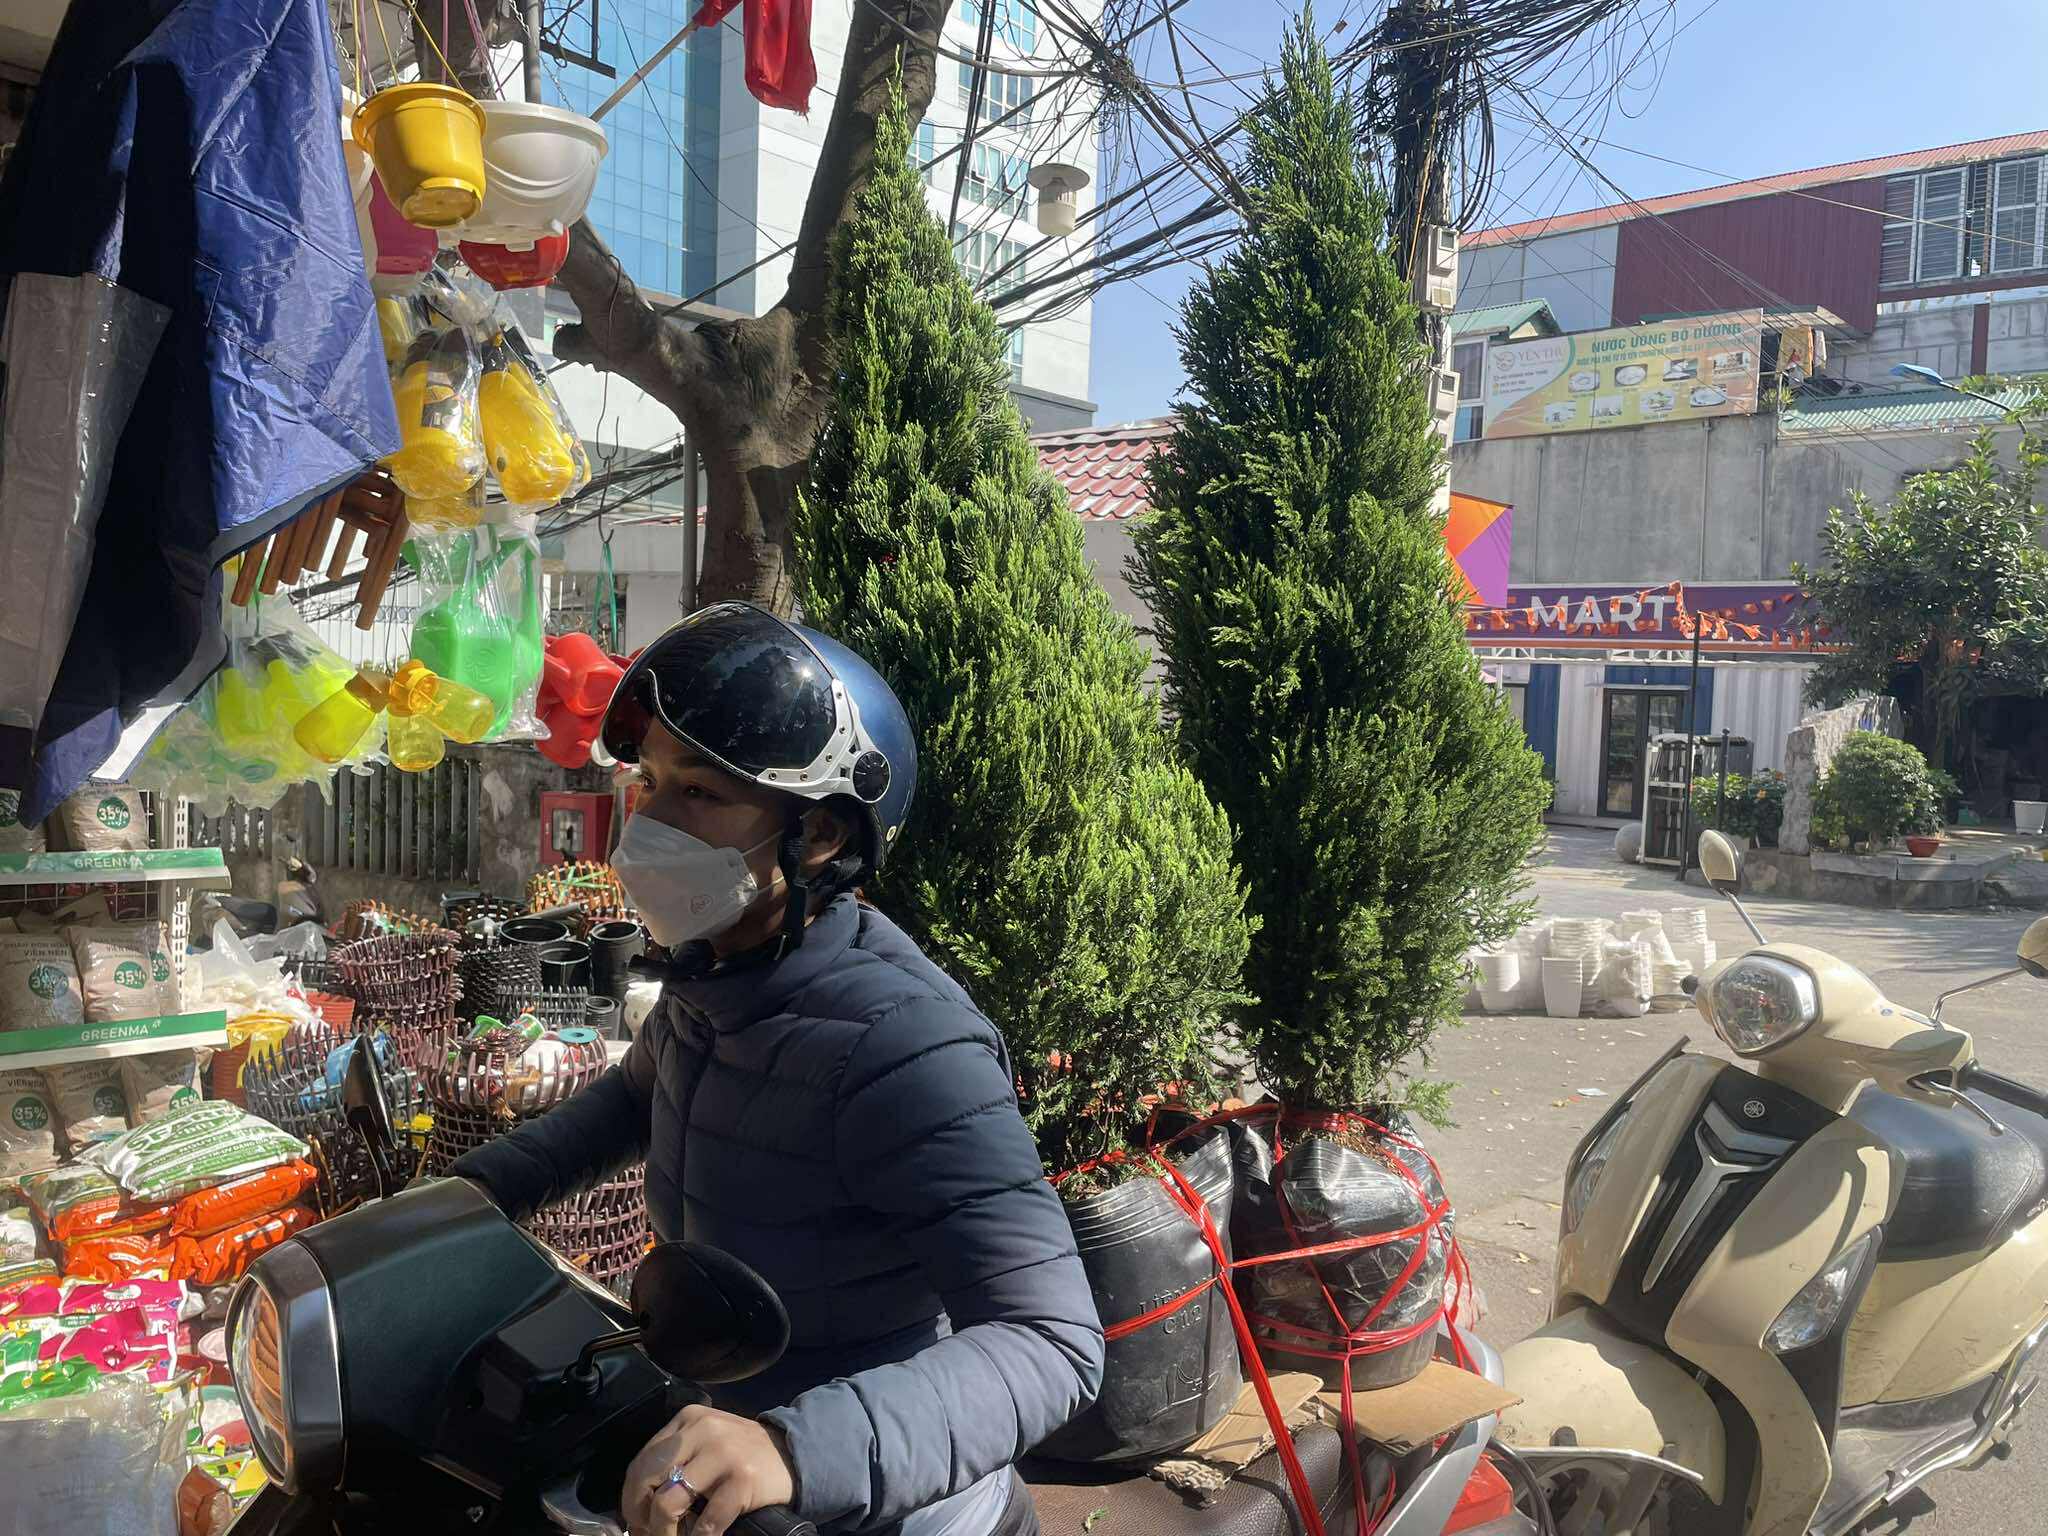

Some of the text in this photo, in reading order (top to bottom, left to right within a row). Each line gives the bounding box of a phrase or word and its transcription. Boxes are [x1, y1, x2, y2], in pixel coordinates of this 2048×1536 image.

[1531, 595, 1675, 632] MART
[98, 803, 130, 822] 35%
[81, 1024, 149, 1042] GREENMA
